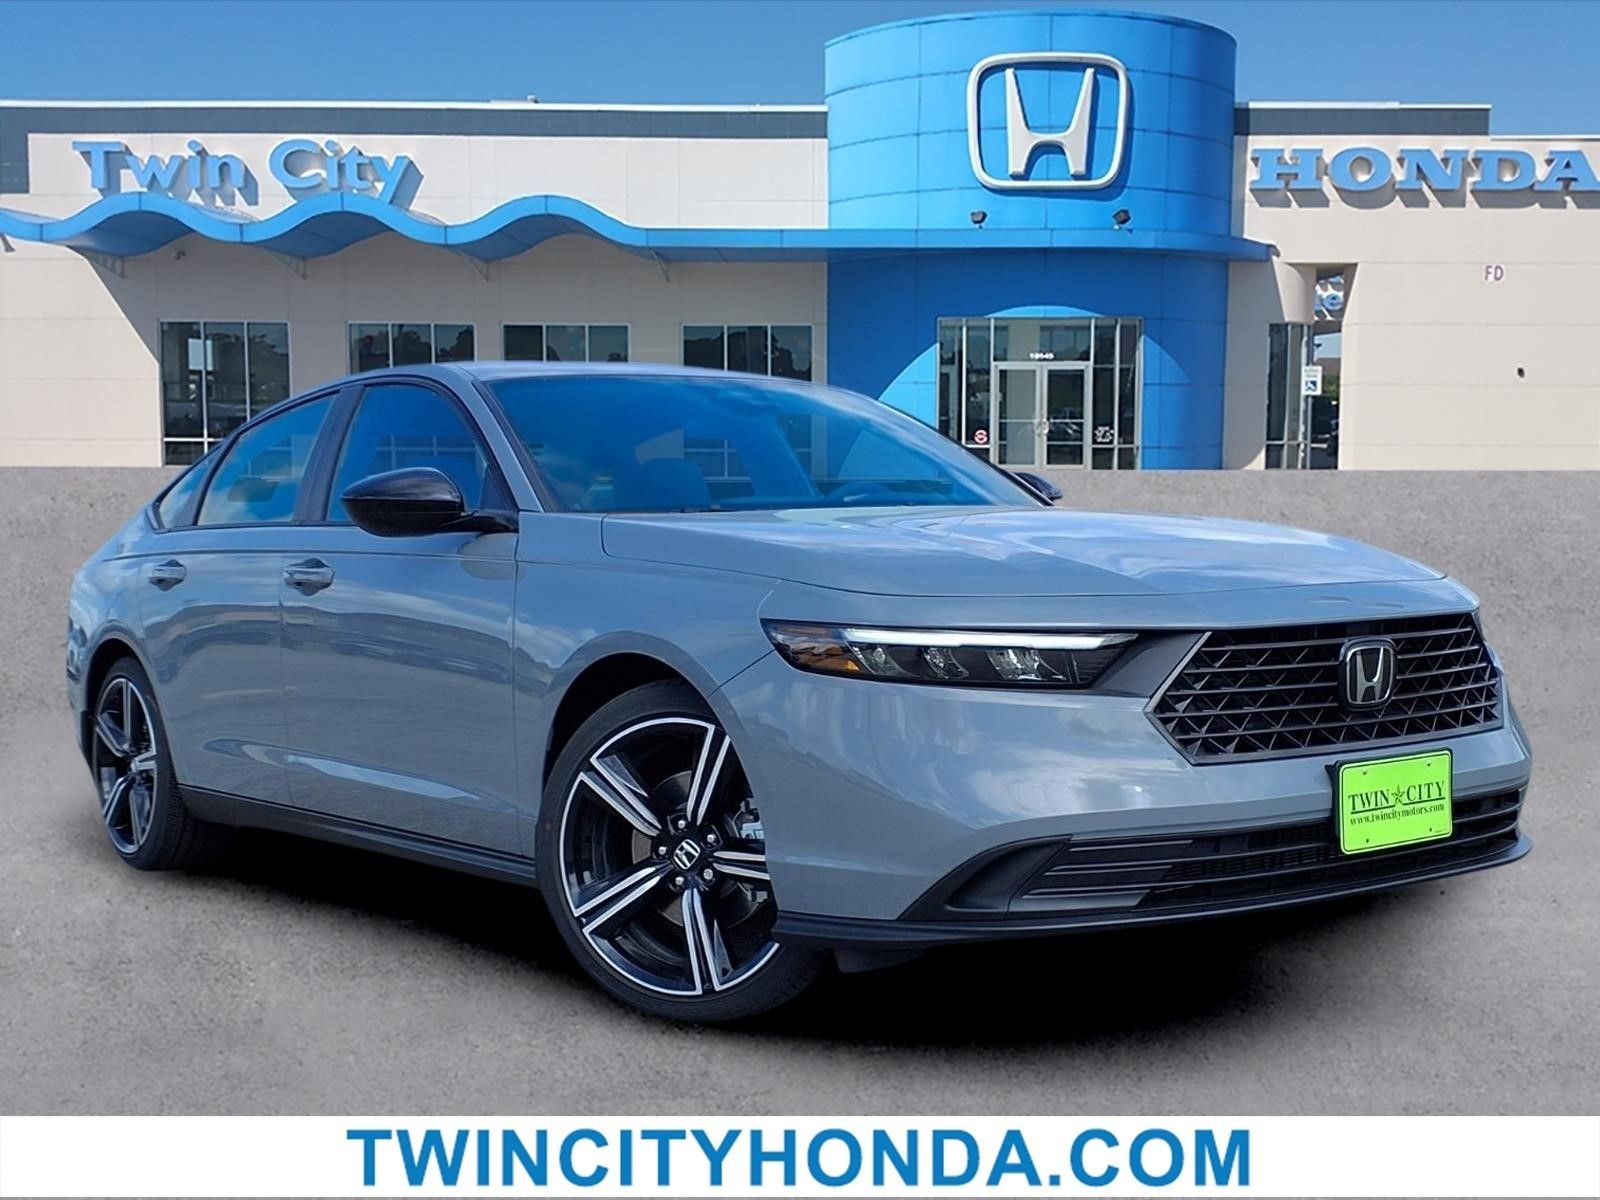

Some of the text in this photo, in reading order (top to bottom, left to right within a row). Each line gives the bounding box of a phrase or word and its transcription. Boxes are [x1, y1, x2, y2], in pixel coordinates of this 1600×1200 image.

[72, 138, 424, 210] Twin City
[1250, 145, 1600, 208] HONDA
[1484, 264, 1505, 281] FD
[1348, 780, 1445, 811] TWIN CITY
[1350, 803, 1445, 825] www.twincitymotors.com
